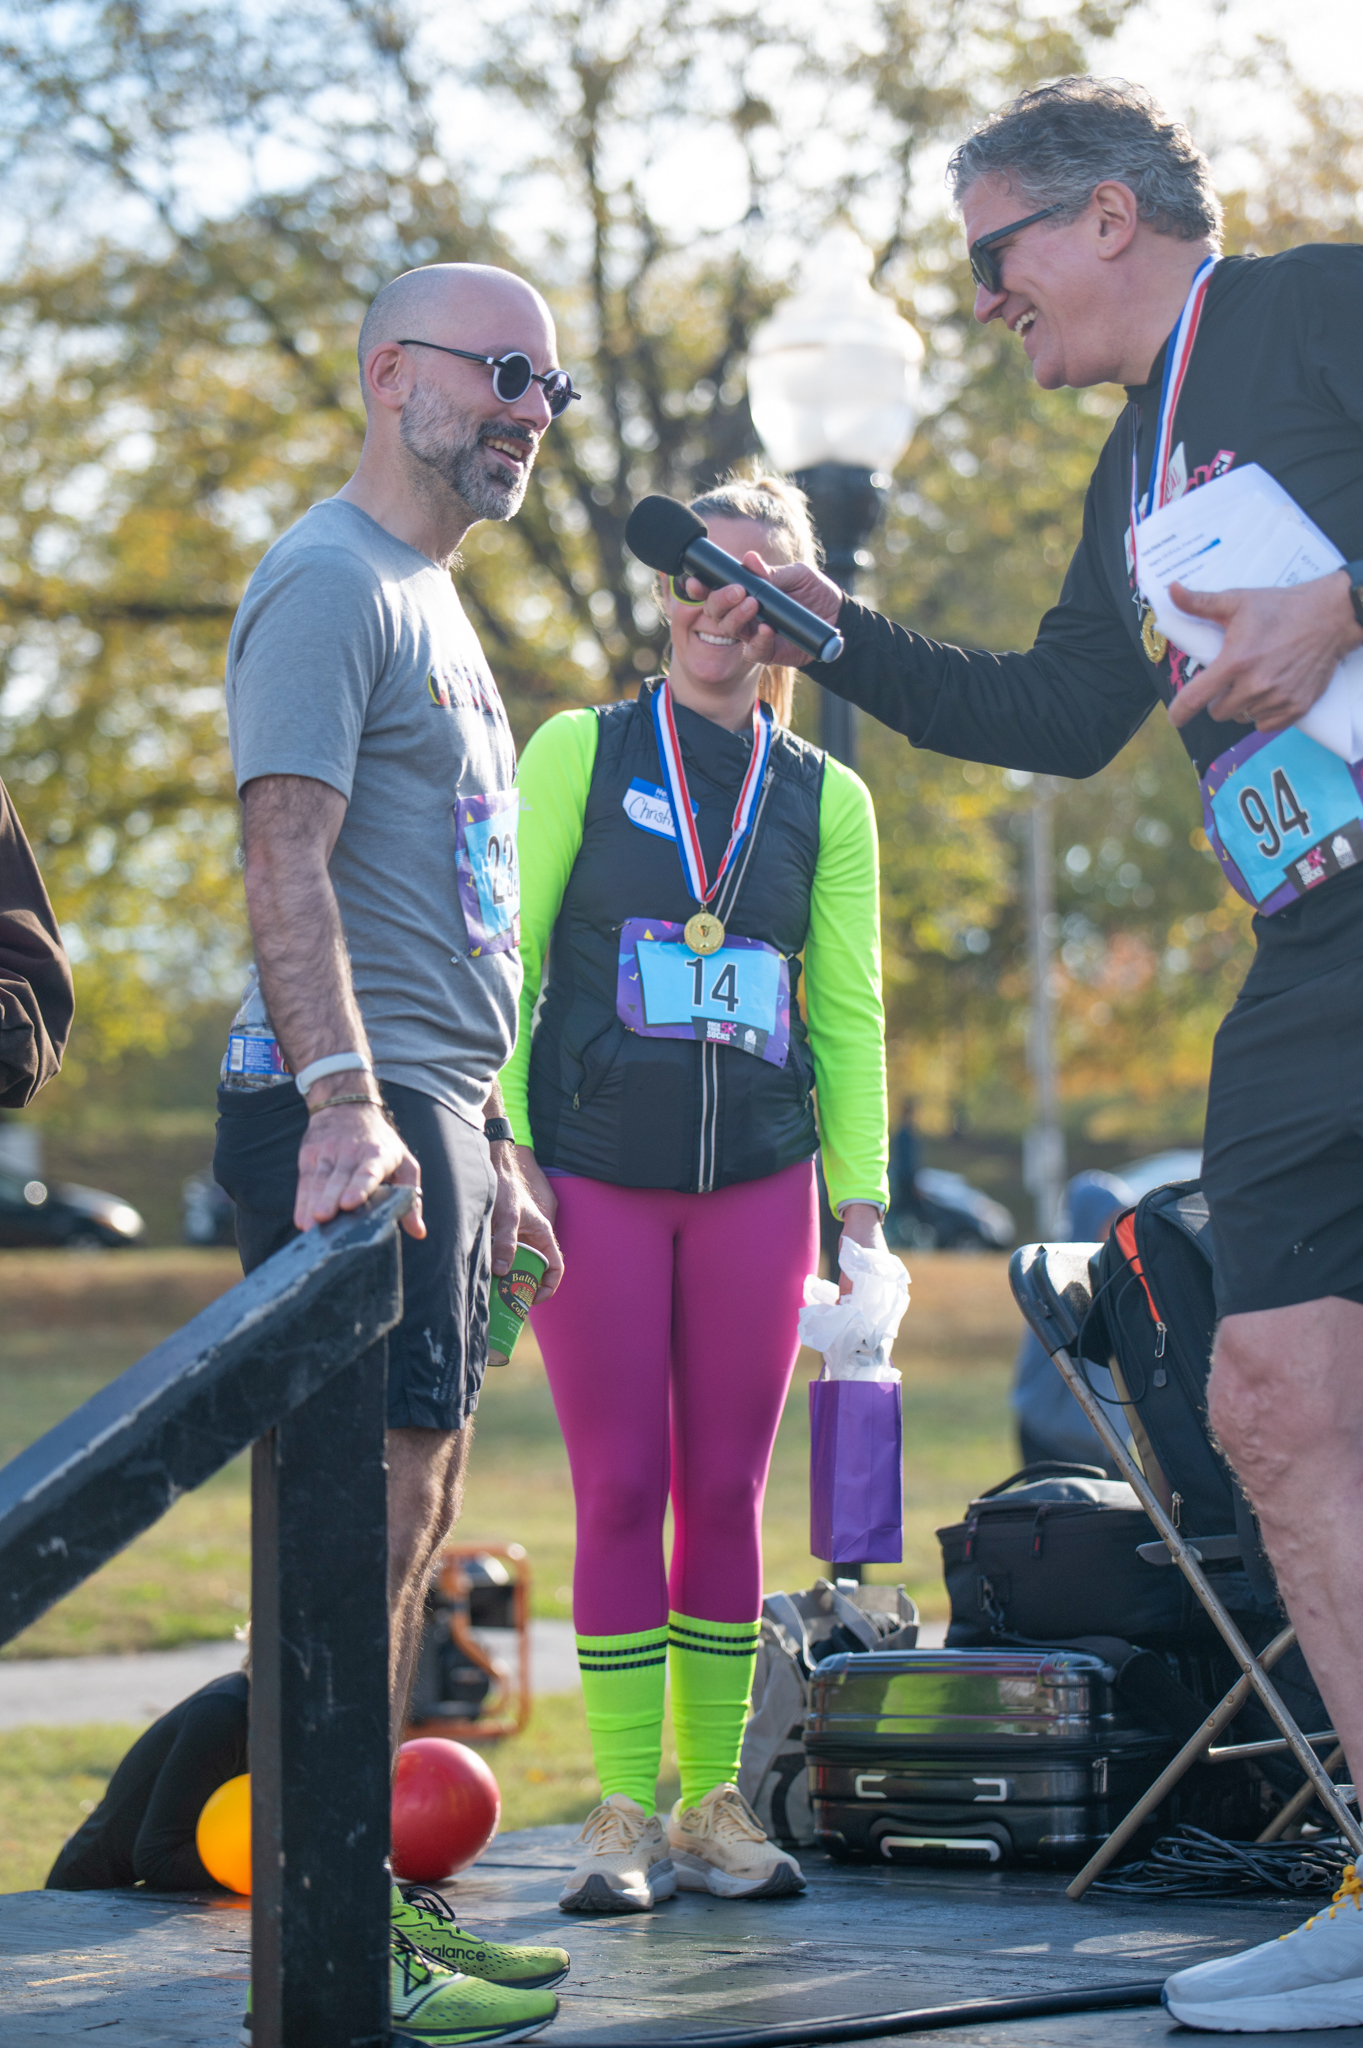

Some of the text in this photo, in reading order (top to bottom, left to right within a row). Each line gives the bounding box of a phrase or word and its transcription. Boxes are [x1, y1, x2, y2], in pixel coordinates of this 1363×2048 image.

[1238, 767, 1311, 859] 94
[685, 957, 740, 1014] 14
[721, 1022, 737, 1036] 5K
